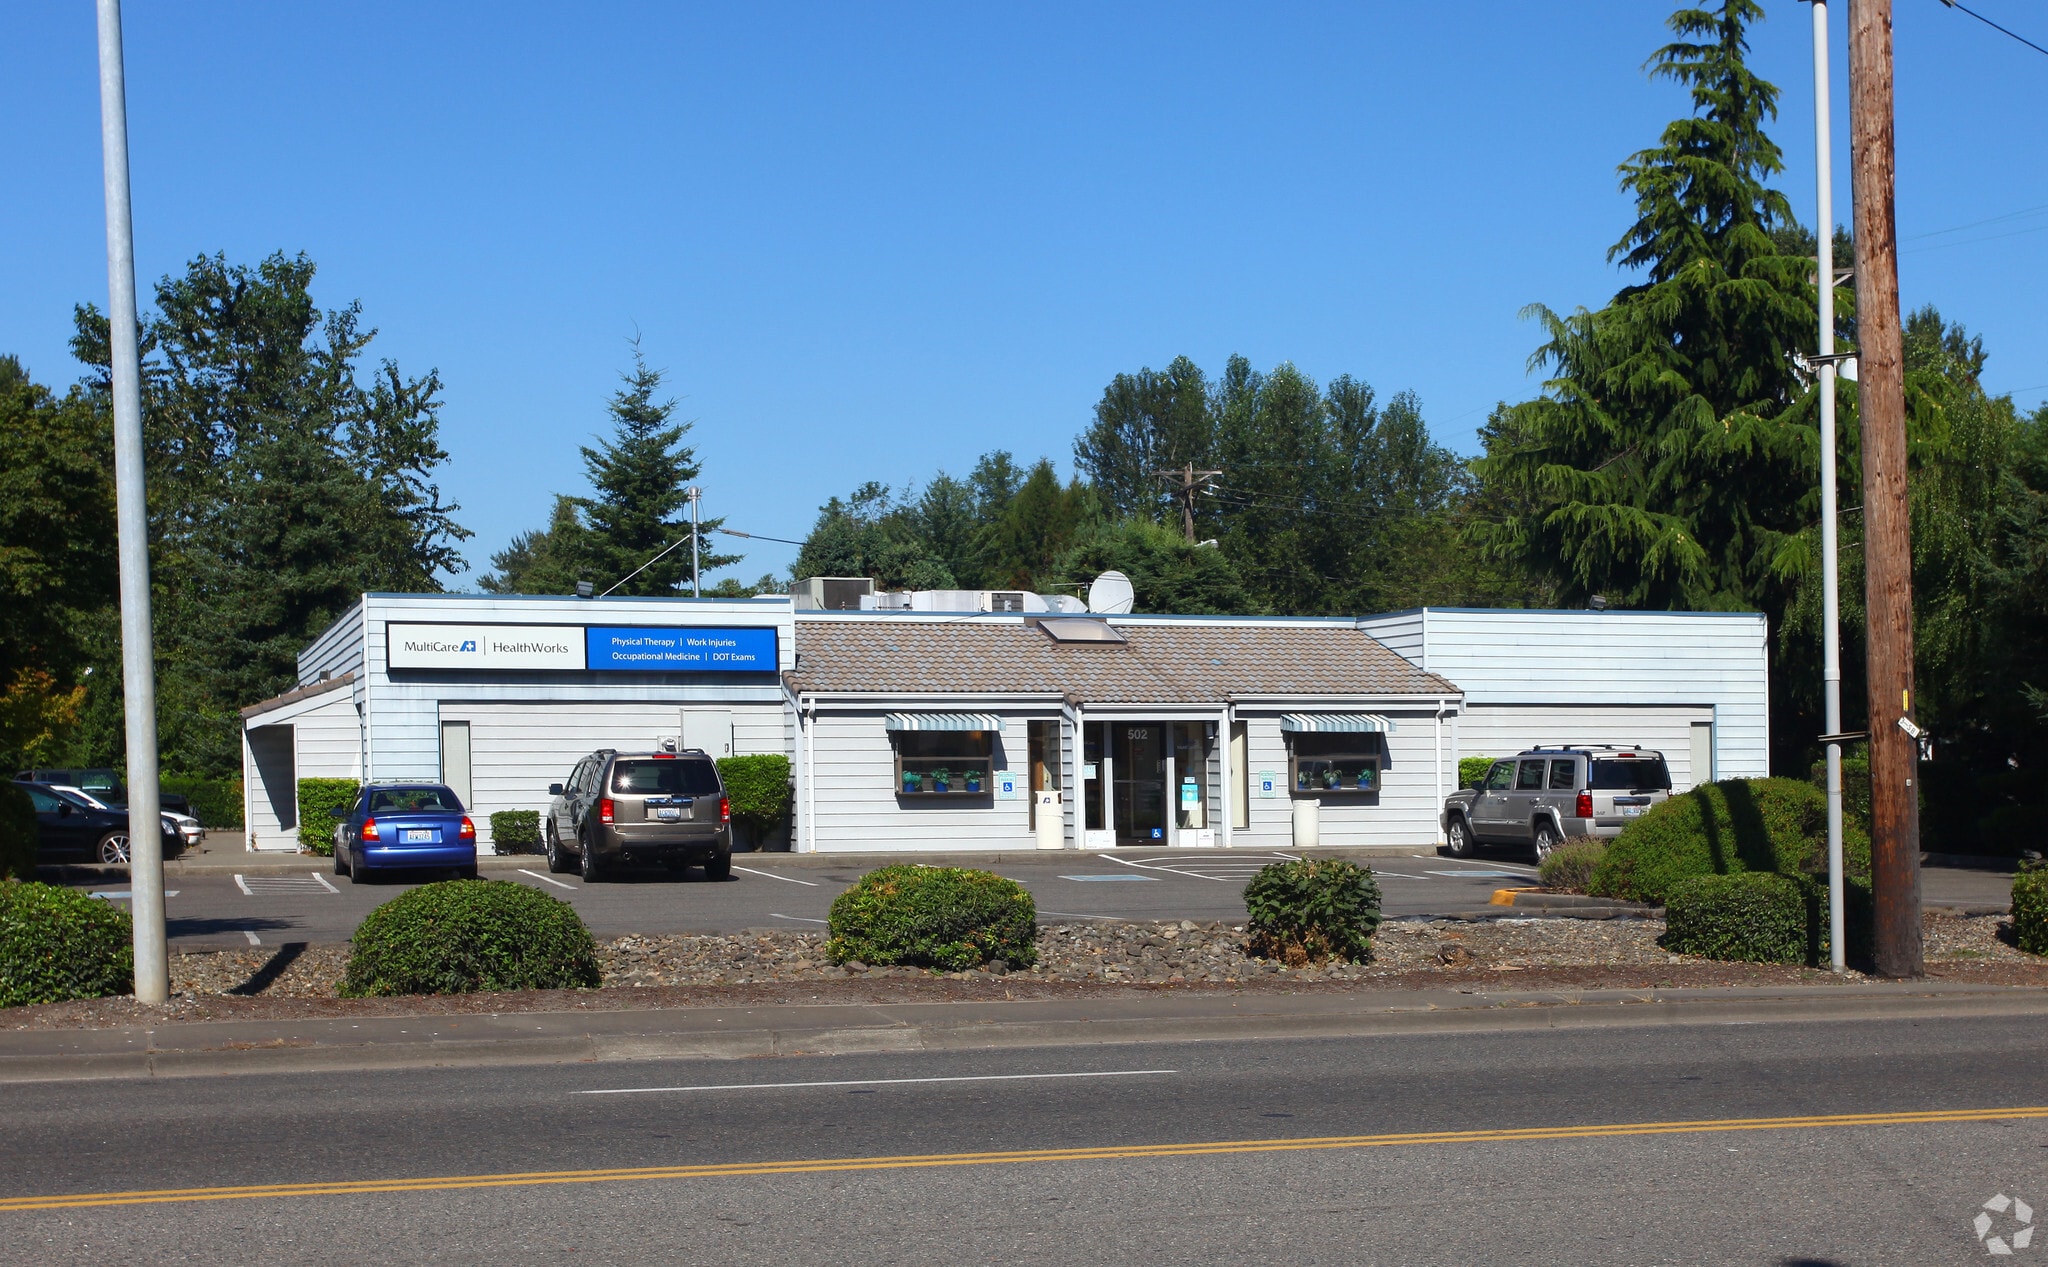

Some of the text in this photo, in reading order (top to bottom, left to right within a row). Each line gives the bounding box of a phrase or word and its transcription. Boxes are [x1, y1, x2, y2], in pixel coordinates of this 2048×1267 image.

[404, 641, 569, 653] MultiCare HealthWorks
[612, 638, 736, 648] Physical Therapy Work Injuries
[612, 652, 756, 661] Occupational Medicine DOT Exams
[1127, 729, 1148, 740] 502
